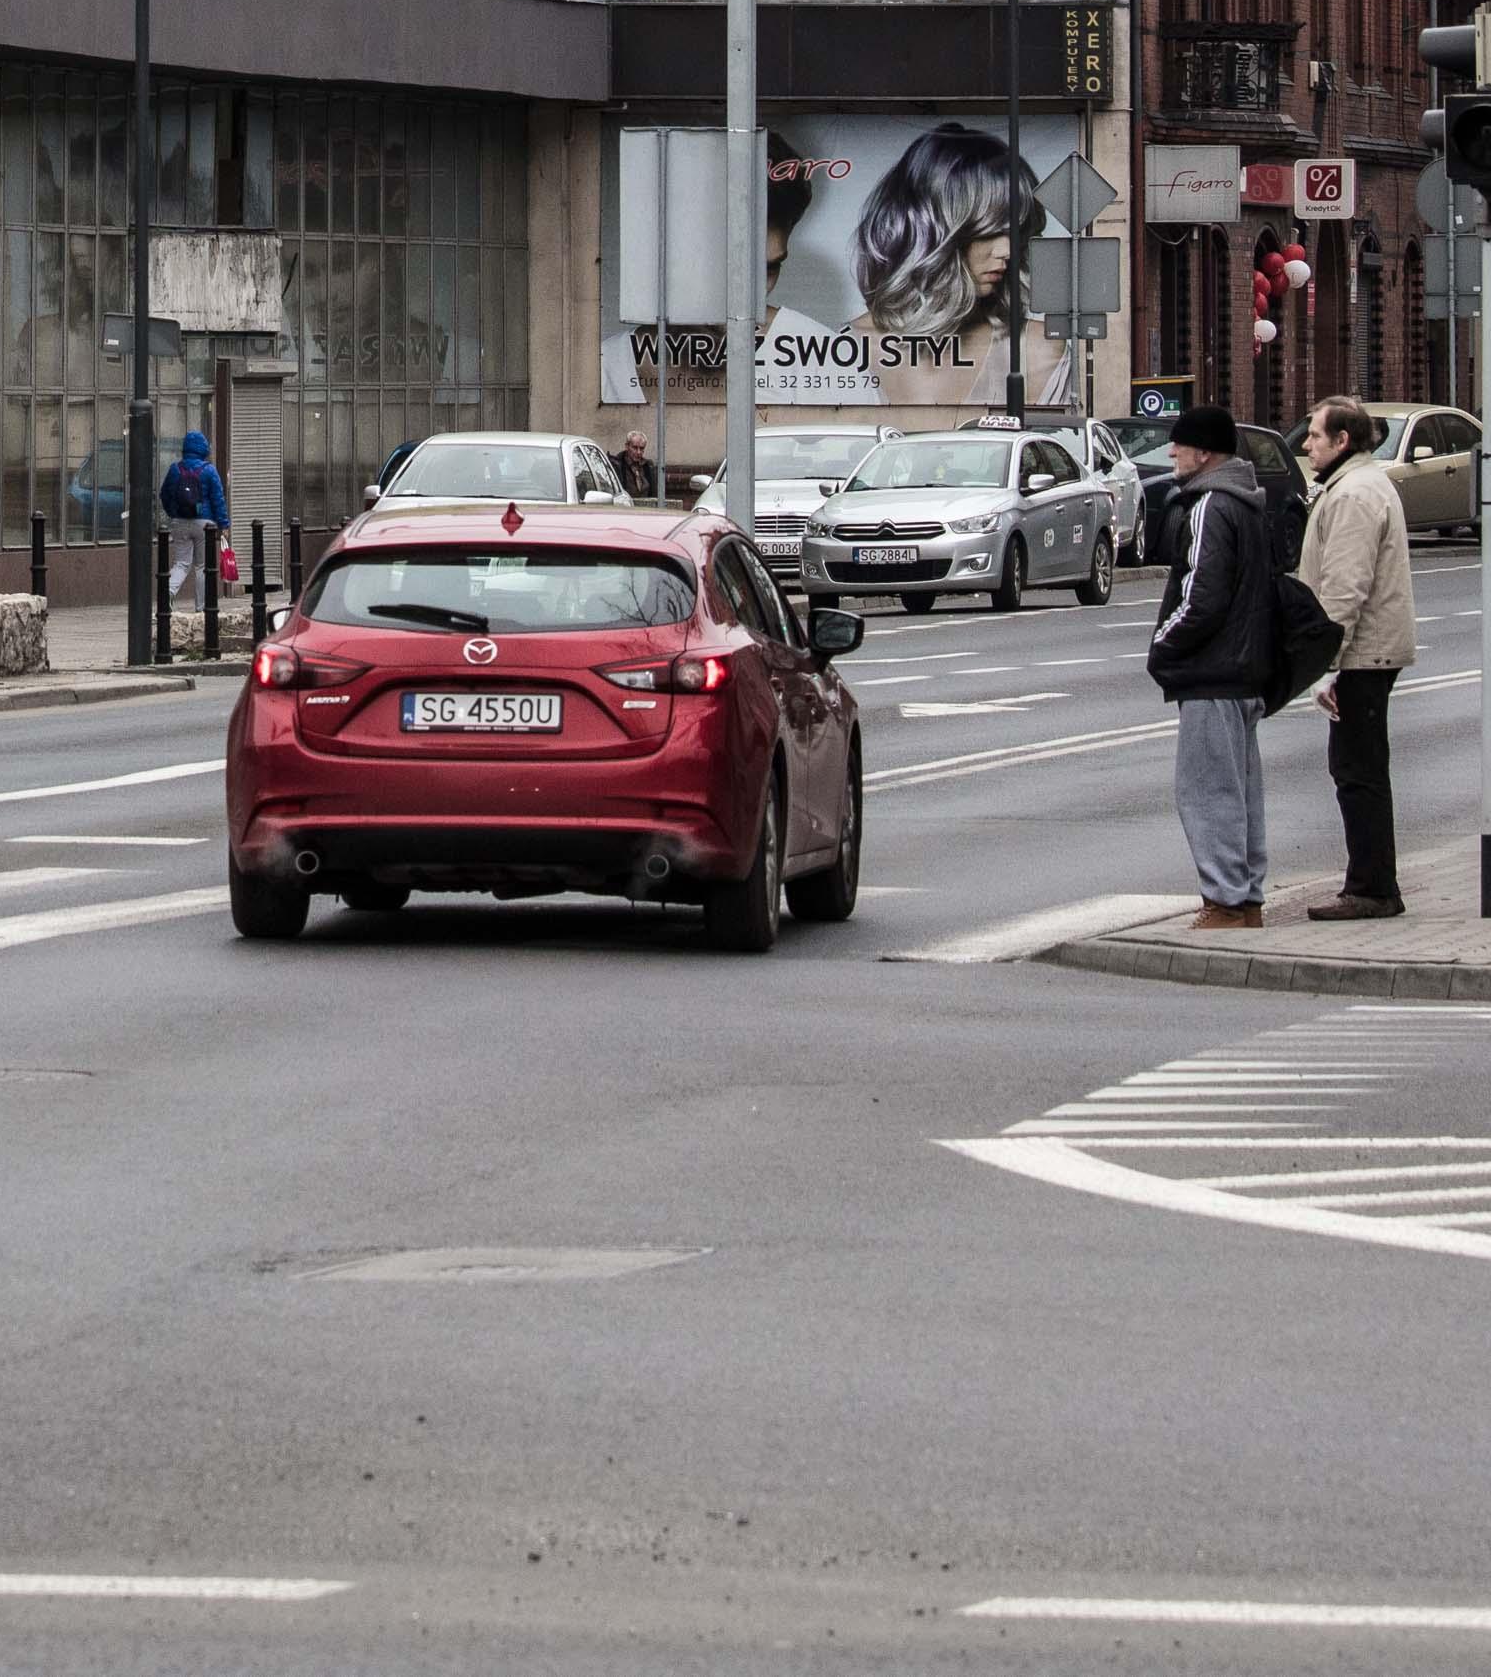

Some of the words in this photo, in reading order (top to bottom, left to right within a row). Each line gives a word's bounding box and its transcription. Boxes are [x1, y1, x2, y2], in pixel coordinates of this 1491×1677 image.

[1066, 10, 1079, 92] KOMPUTERY
[1086, 10, 1101, 92] XERO
[773, 326, 869, 372] SWÓJ
[878, 334, 974, 368] STYL
[780, 376, 798, 388] 32
[803, 376, 831, 388] 331
[837, 376, 857, 388] 55
[862, 376, 880, 388] 79
[860, 550, 877, 561] SG
[881, 549, 915, 561] 2884L
[421, 697, 456, 722] SG
[467, 696, 554, 724] 4550U
